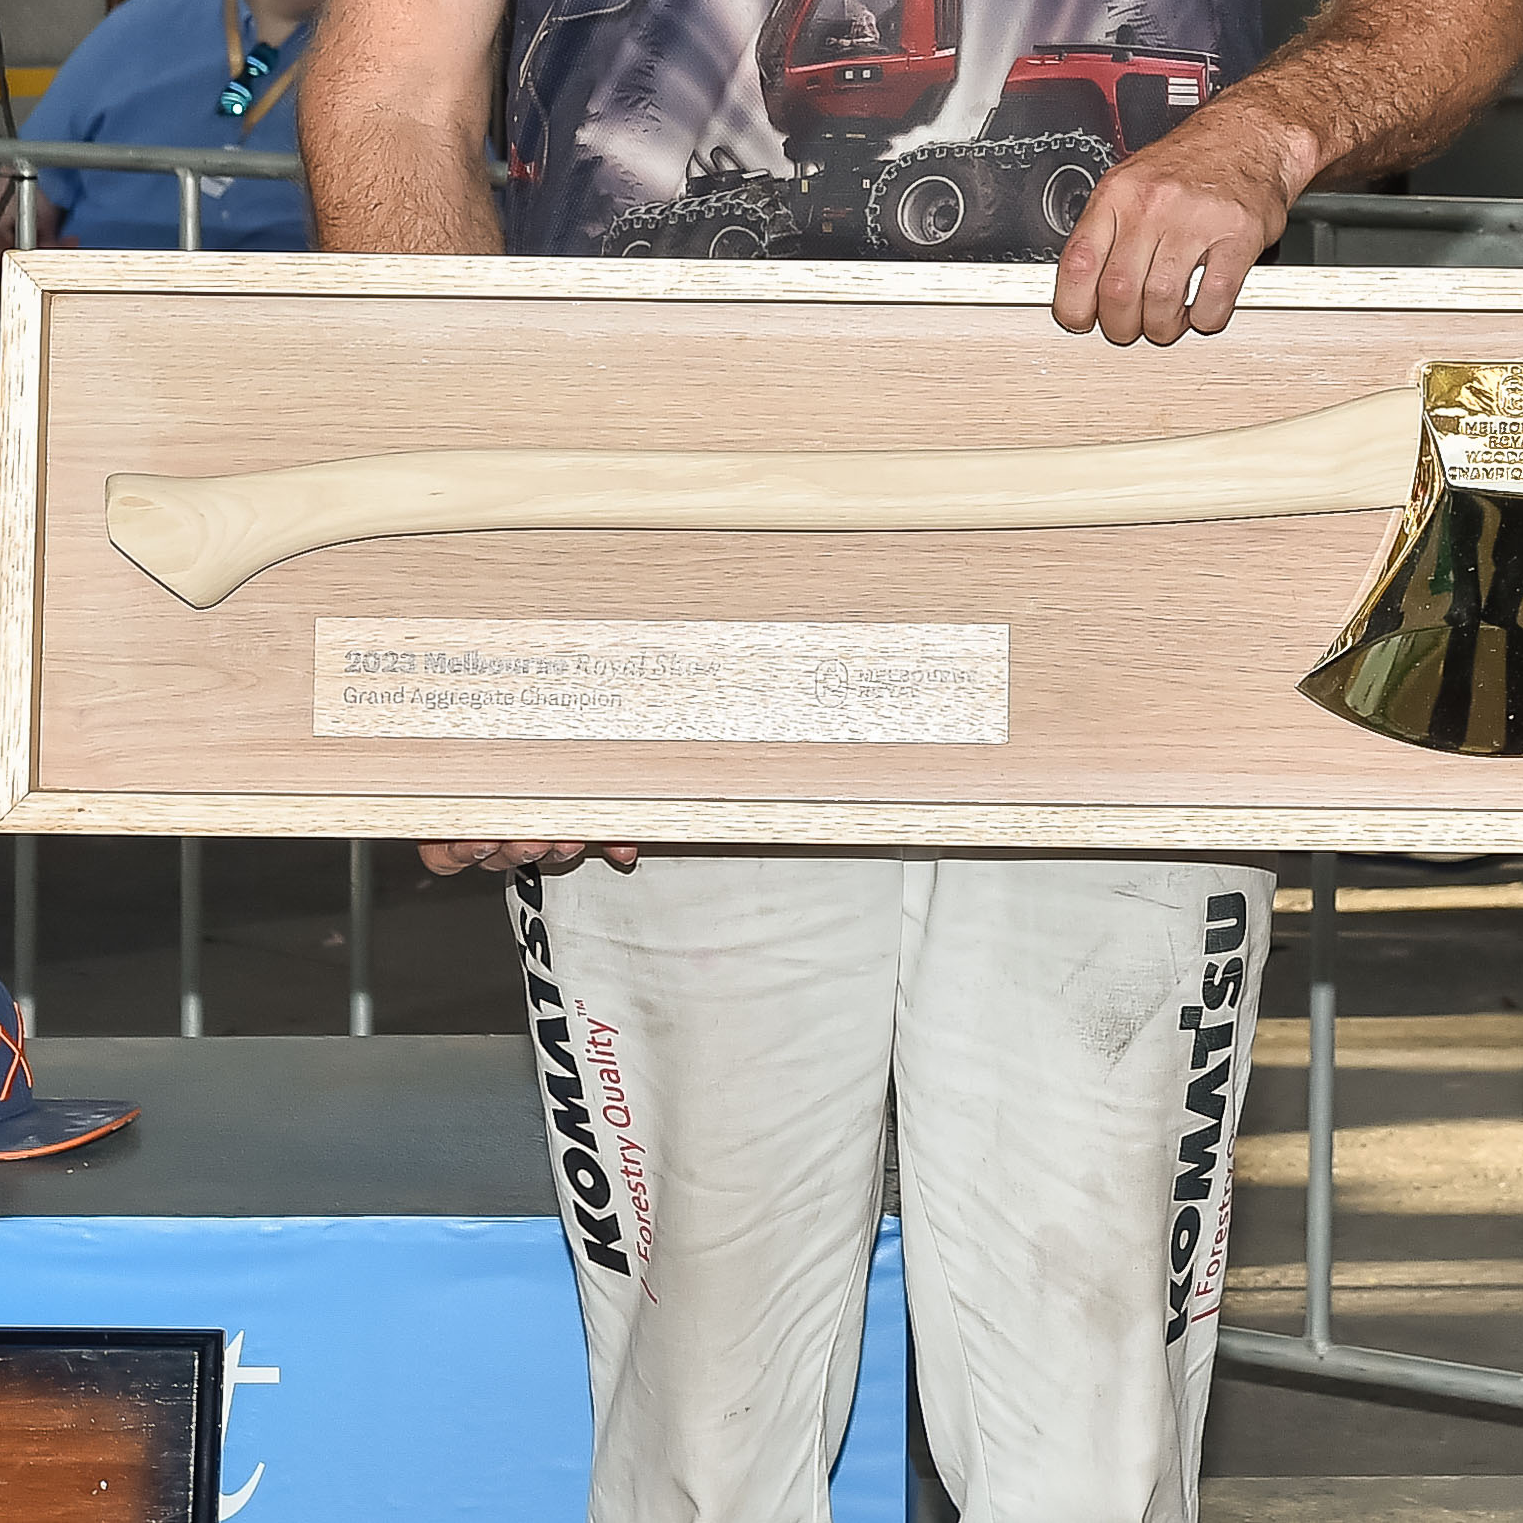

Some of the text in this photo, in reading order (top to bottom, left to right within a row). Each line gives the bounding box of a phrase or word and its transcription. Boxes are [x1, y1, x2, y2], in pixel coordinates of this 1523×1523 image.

[343, 686, 623, 710] Grand Aggregate Champion
[1165, 891, 1248, 1346] KOMATSU
[616, 1134, 655, 1265] Forestry
